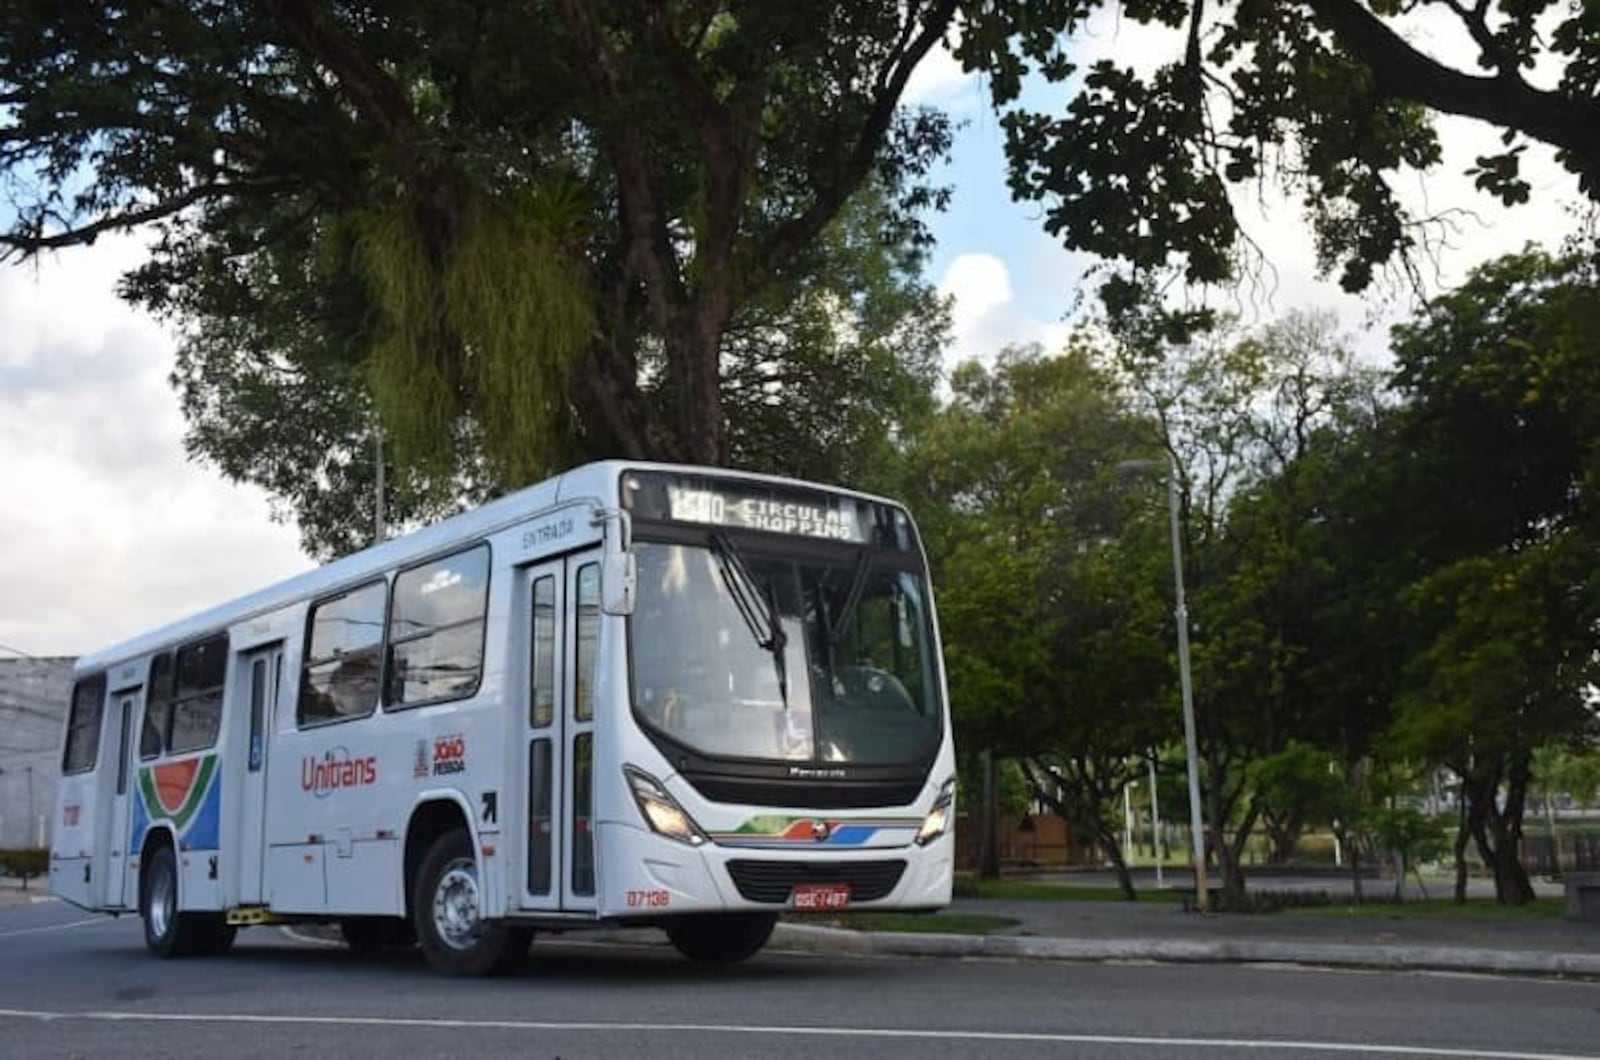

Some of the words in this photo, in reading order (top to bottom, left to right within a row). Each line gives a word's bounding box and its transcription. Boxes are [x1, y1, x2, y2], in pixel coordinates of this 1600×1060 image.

[523, 518, 574, 550] ENTRADA
[301, 752, 377, 792] Unitrans
[627, 890, 669, 906] 07138
